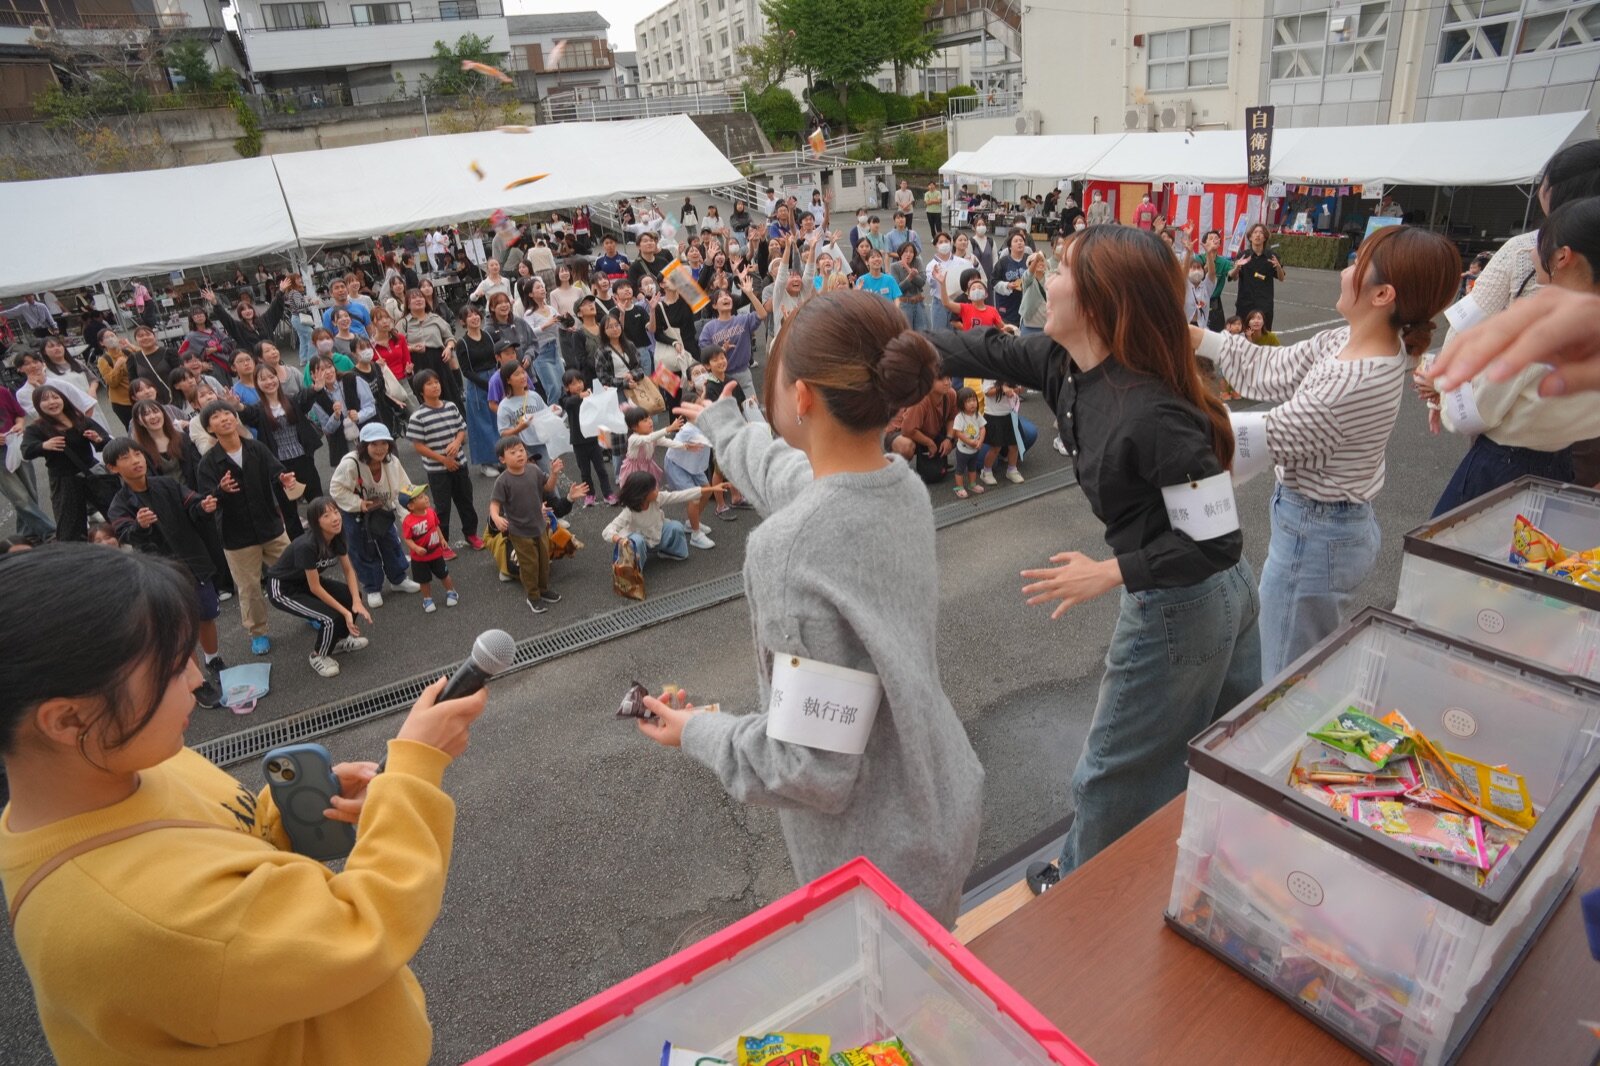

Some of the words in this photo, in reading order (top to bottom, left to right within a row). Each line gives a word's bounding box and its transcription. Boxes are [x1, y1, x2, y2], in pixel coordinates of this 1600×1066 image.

[1250, 110, 1268, 172] 自衛隊
[802, 696, 858, 725] 執行部
